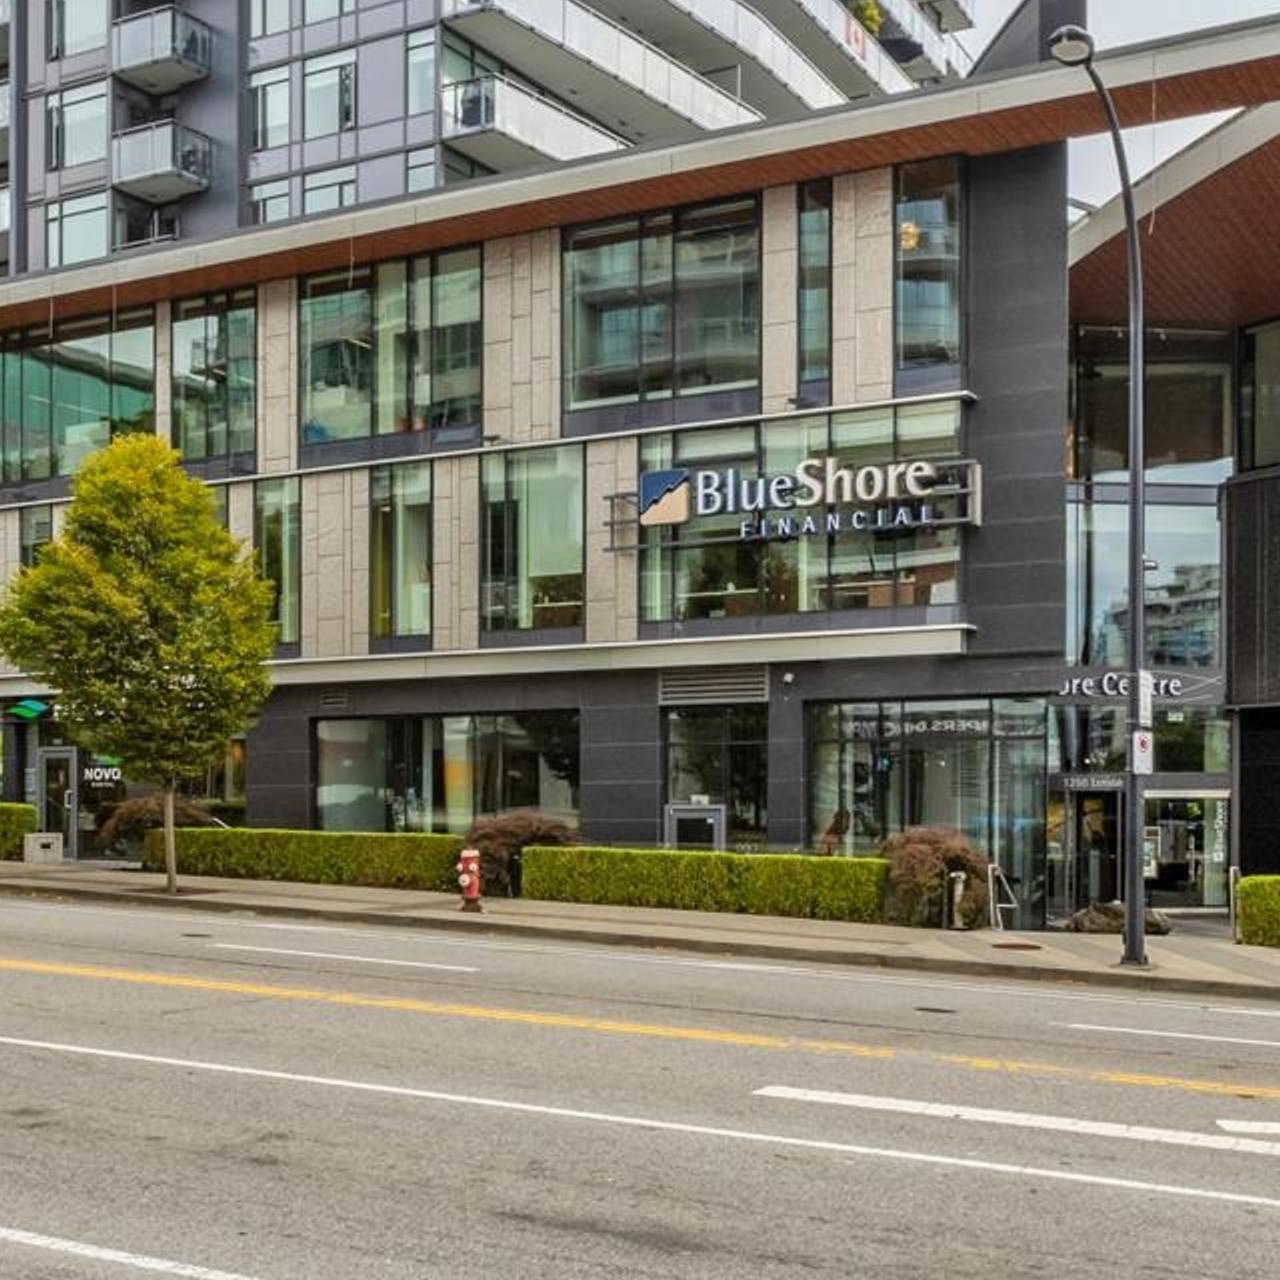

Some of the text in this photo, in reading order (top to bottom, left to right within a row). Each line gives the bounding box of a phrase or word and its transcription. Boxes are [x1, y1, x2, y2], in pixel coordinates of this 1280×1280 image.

[696, 457, 937, 516] BlueShore
[740, 505, 935, 539] FINANCIAL
[1102, 672, 1183, 696] Cetre
[83, 767, 122, 781] NOVO
